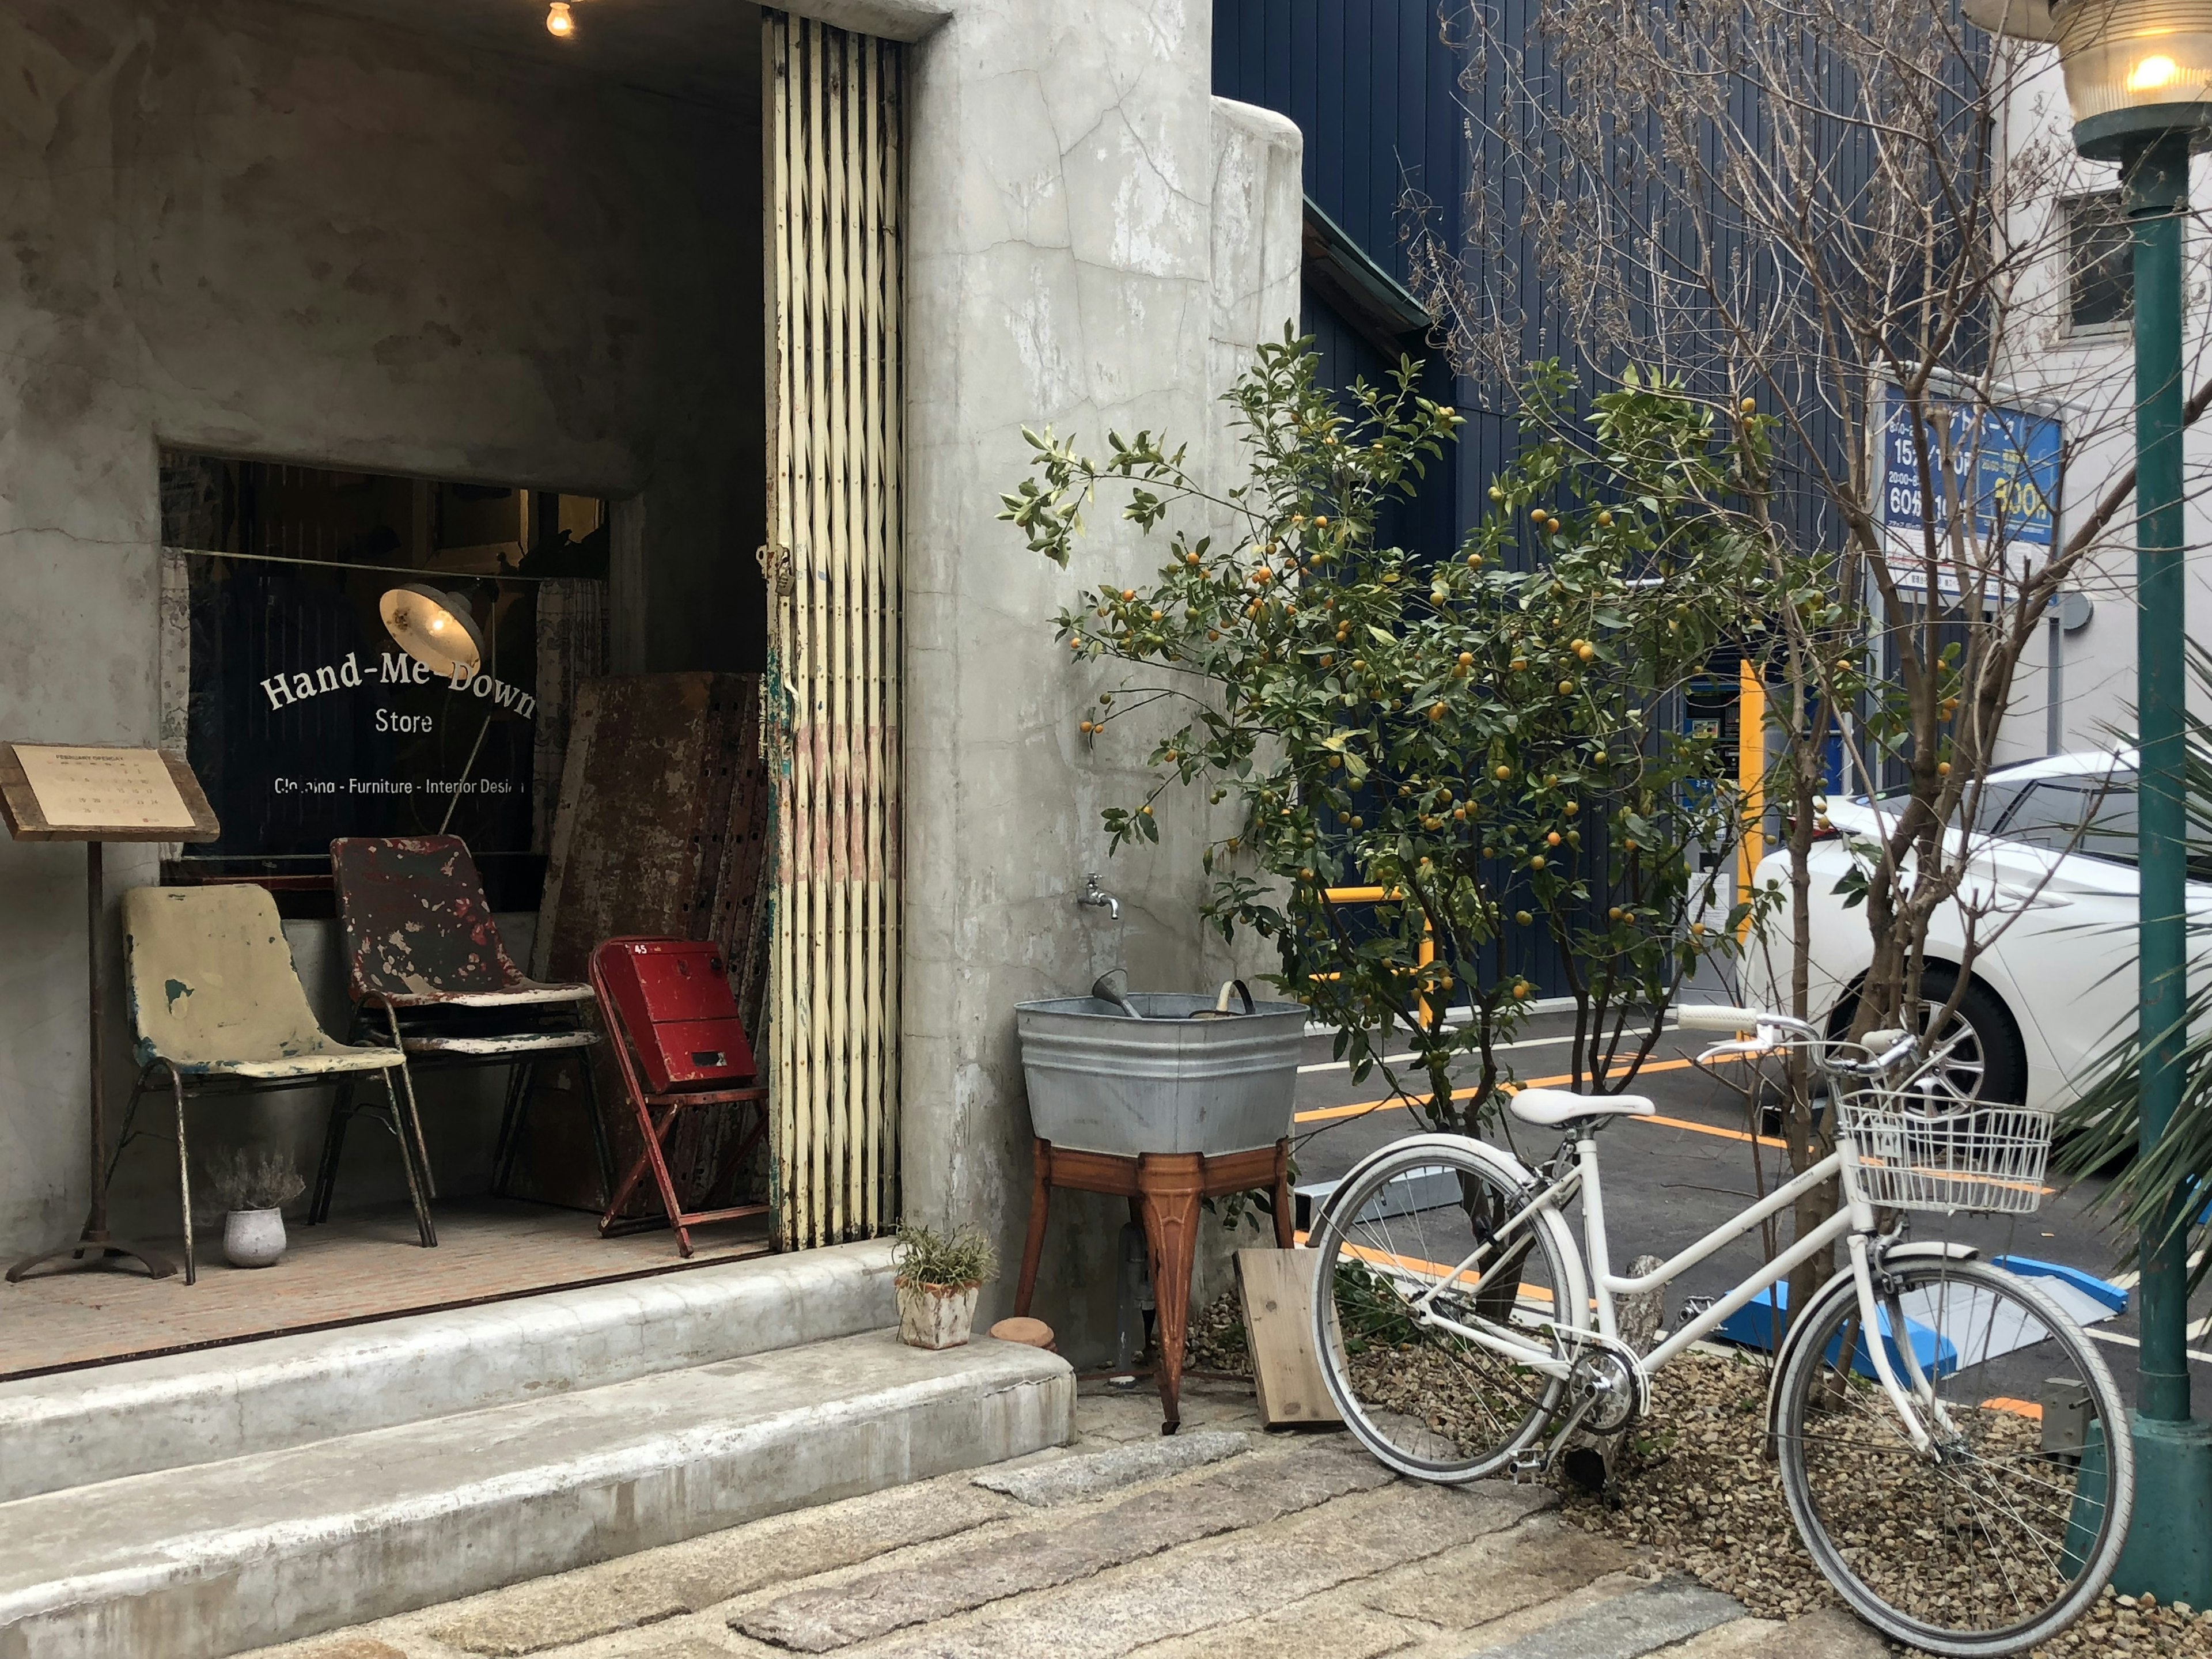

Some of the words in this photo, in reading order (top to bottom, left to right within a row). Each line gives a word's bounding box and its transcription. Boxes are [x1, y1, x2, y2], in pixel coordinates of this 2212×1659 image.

[376, 708, 432, 733] Store
[349, 778, 412, 793] Furniture
[426, 778, 477, 793] Interior
[635, 945, 647, 954] 45
